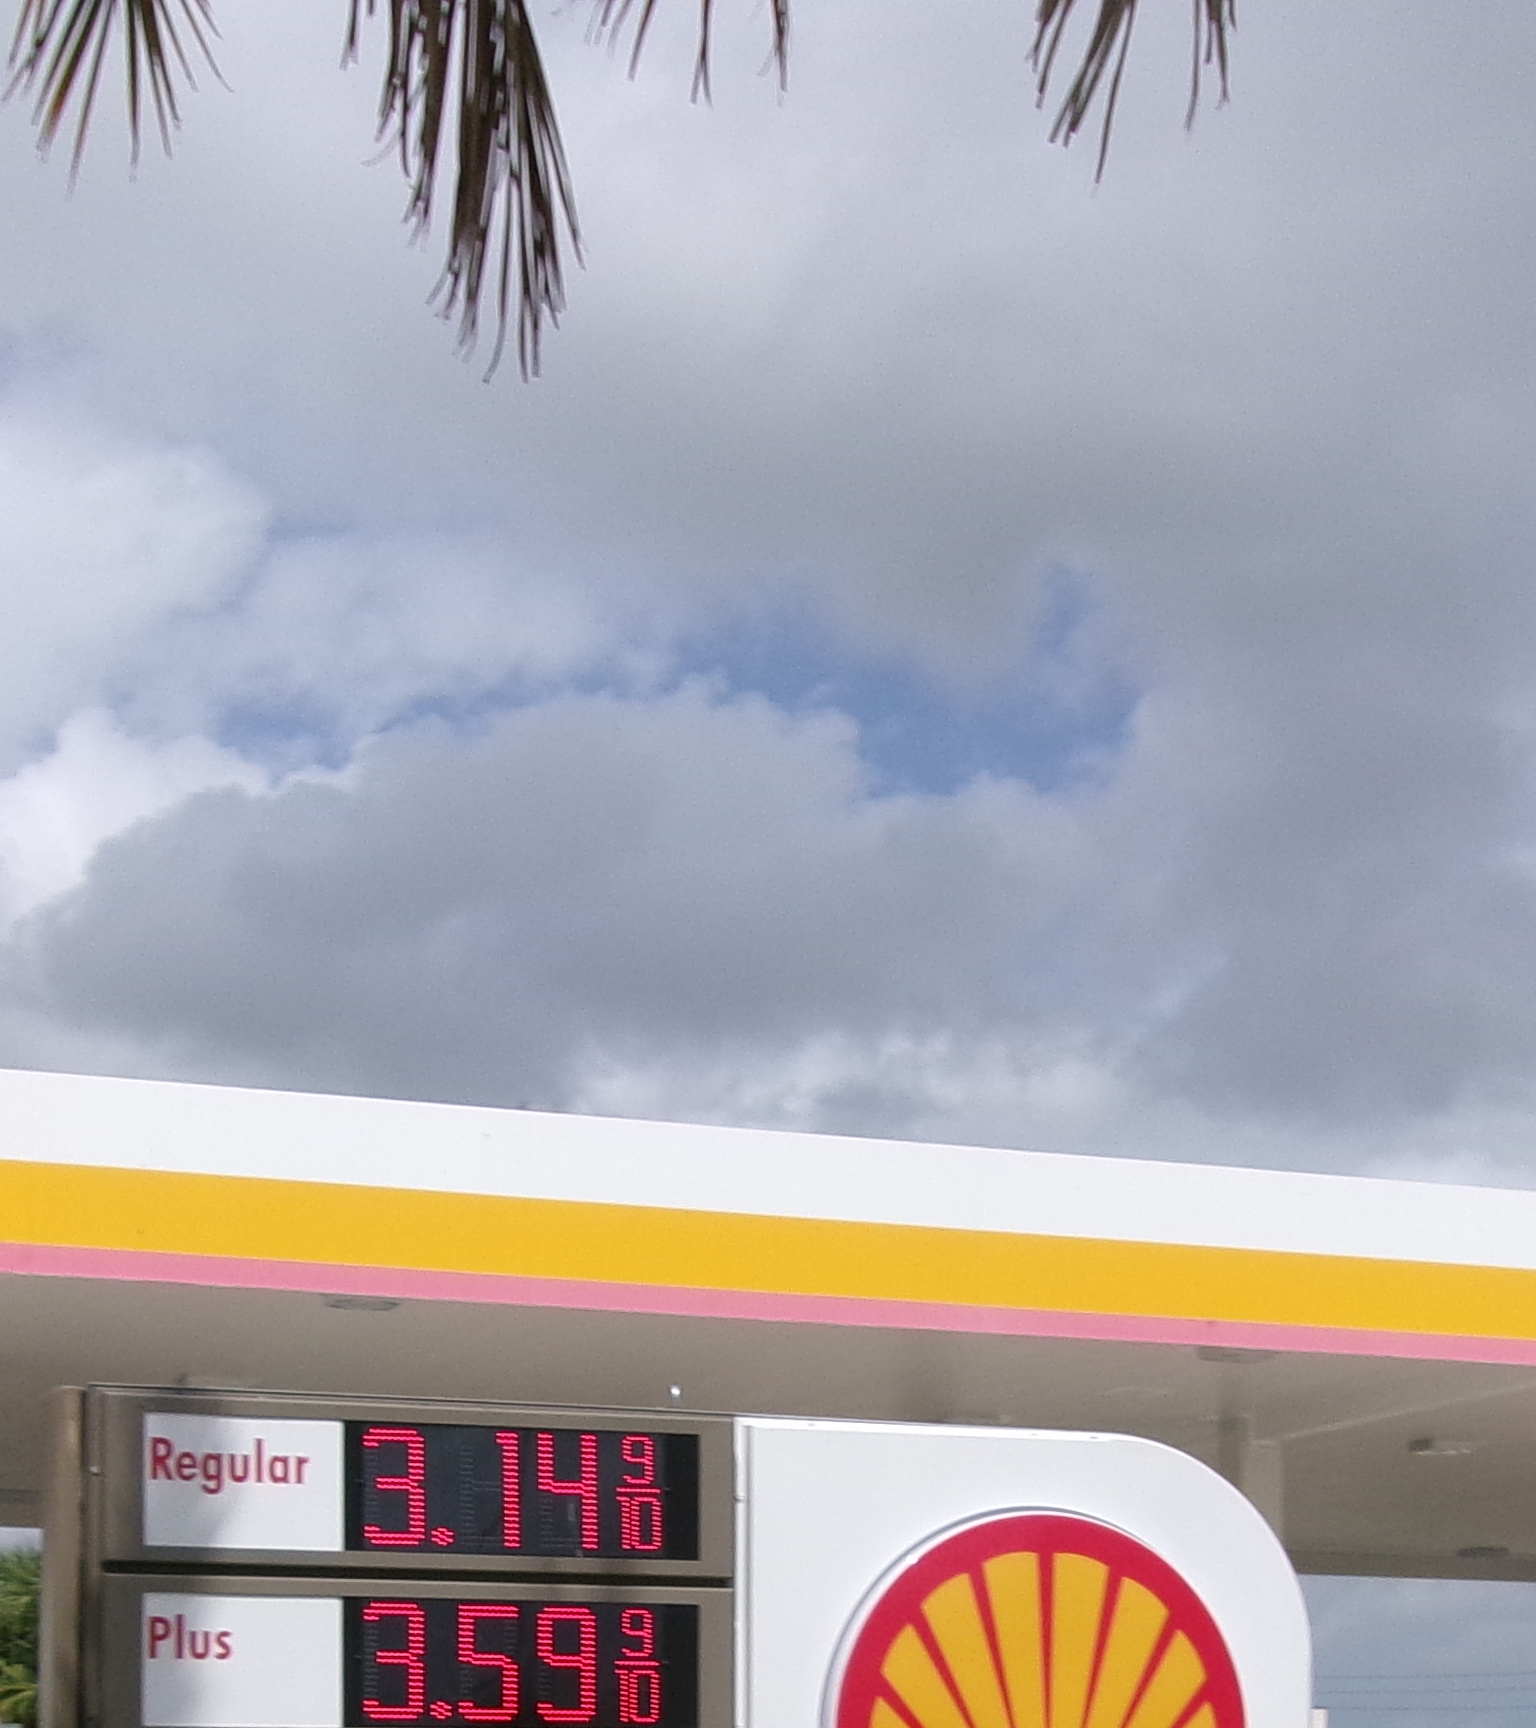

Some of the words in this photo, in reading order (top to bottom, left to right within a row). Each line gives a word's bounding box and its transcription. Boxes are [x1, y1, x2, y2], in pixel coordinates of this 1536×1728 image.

[150, 1435, 310, 1495] Regular
[362, 1427, 599, 1551] 3.14
[149, 1615, 233, 1660] Plus
[362, 1601, 598, 1724] 3.59
